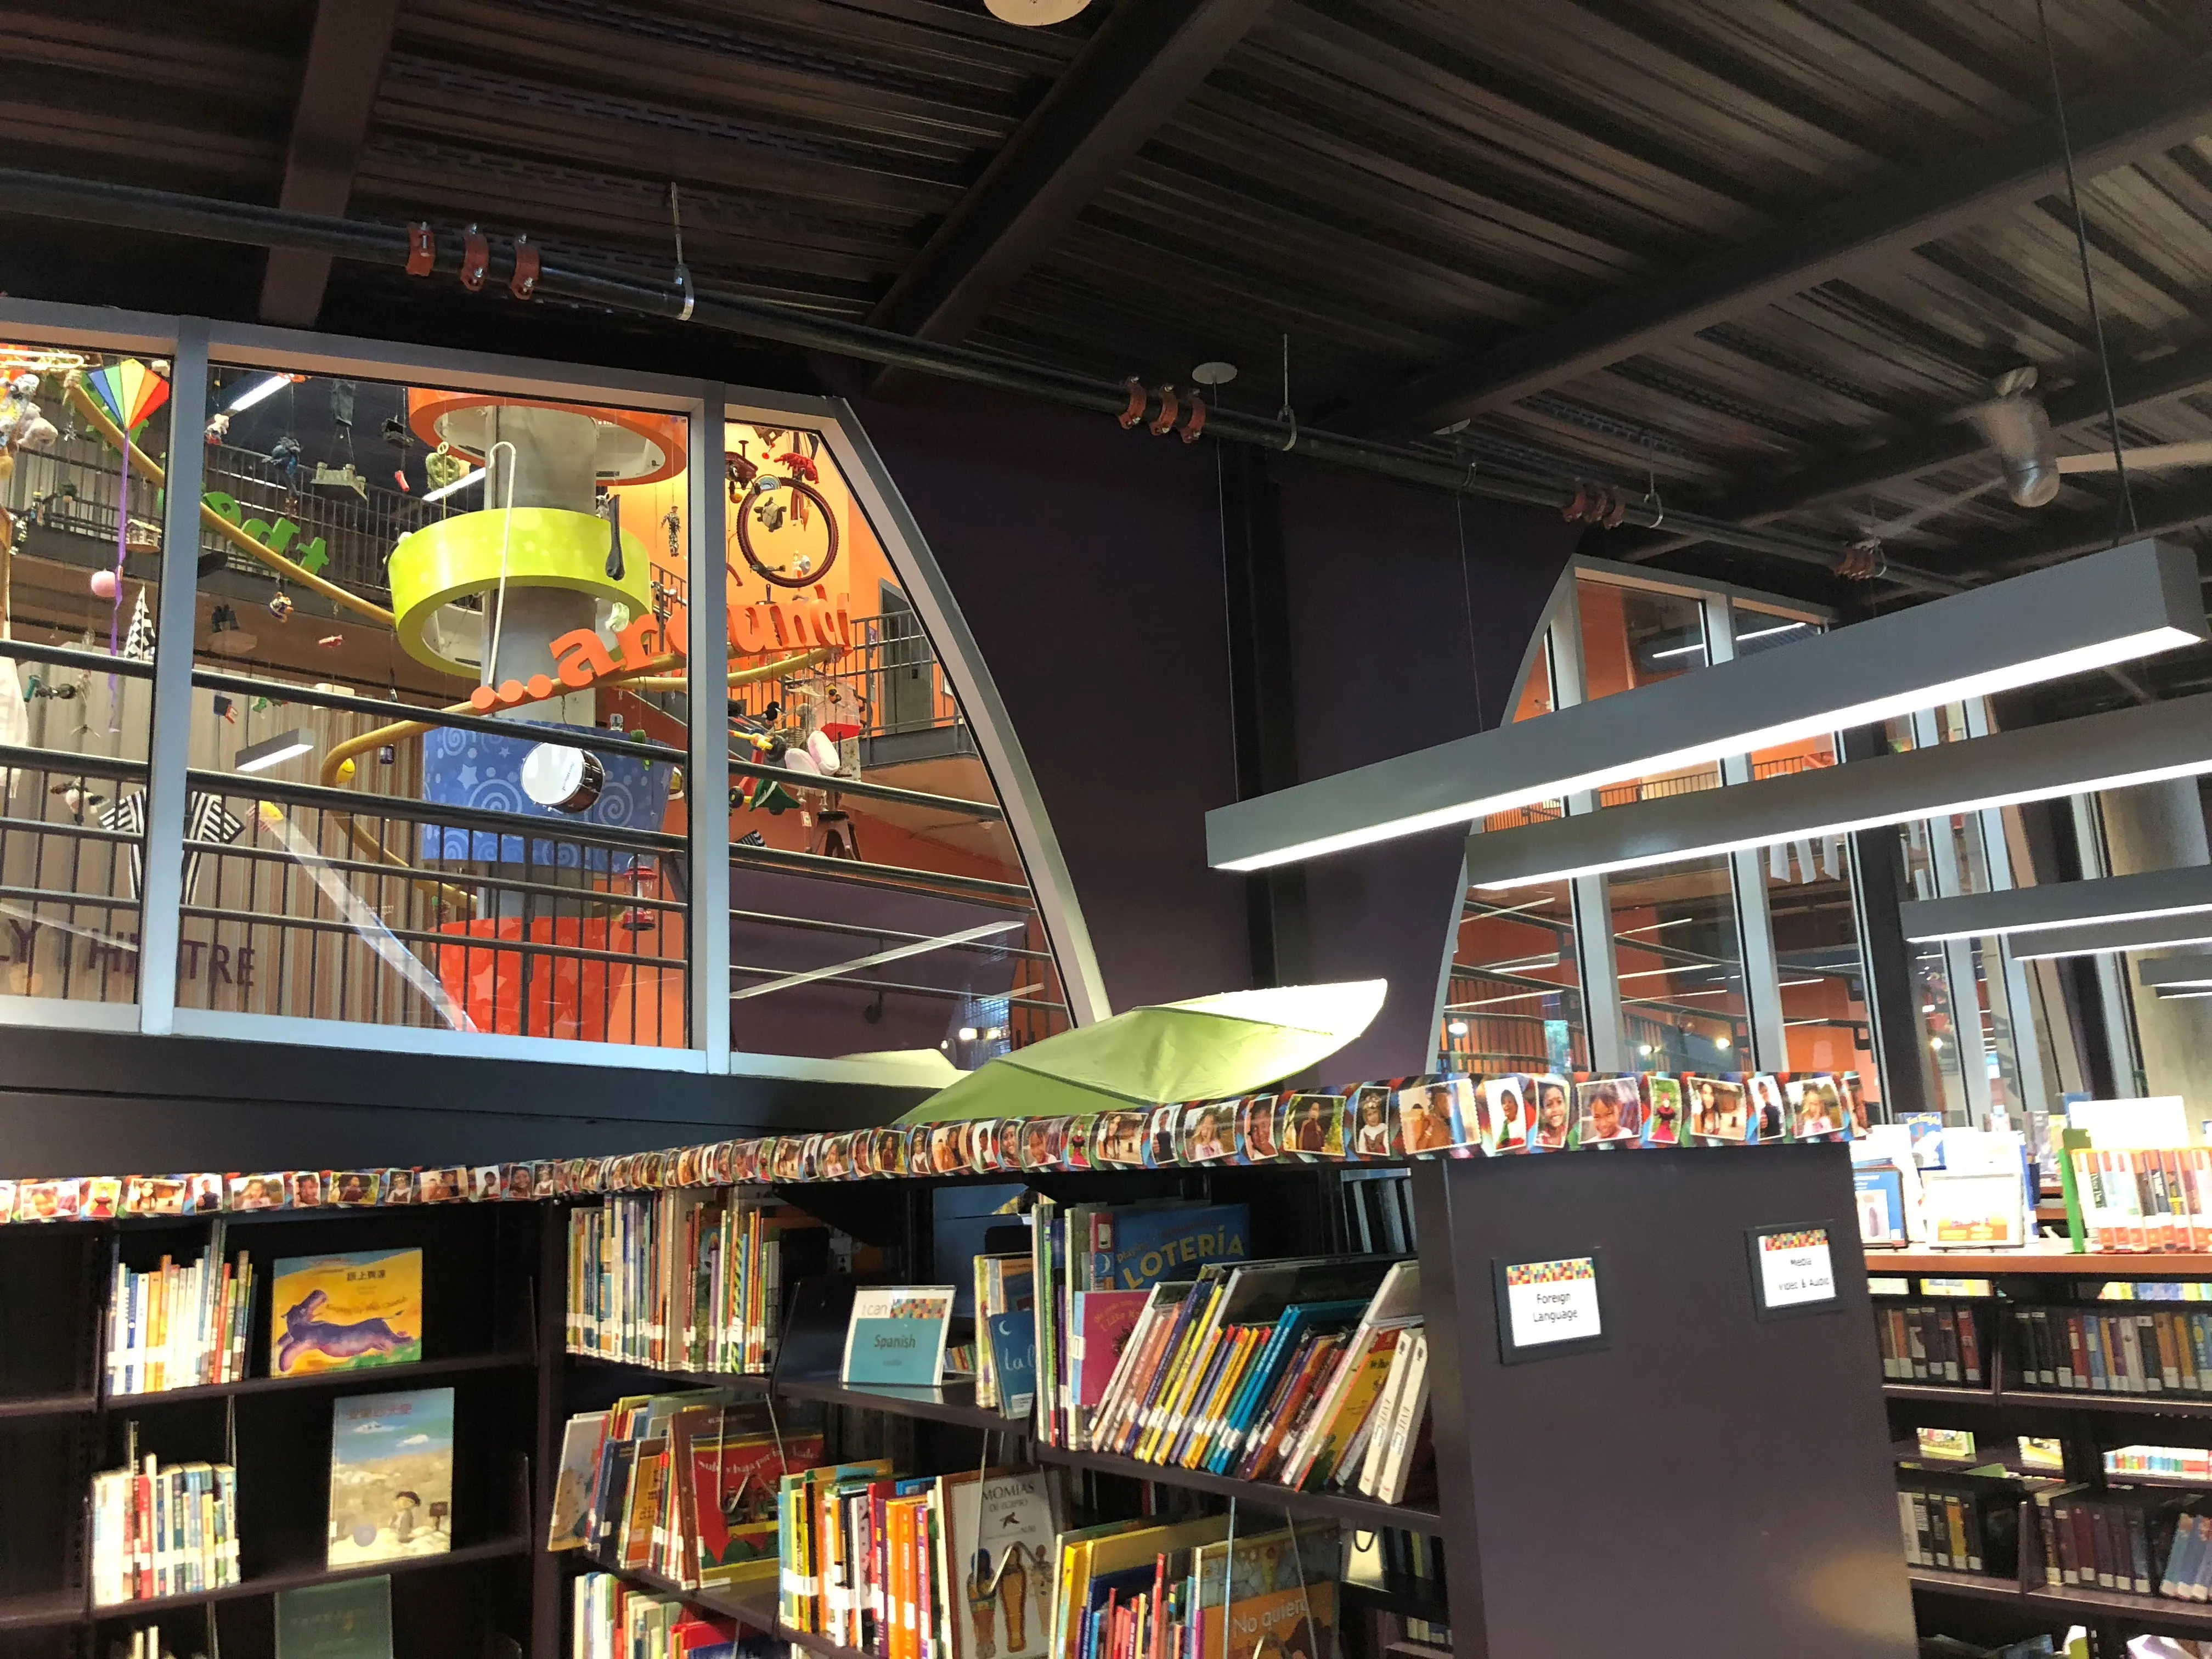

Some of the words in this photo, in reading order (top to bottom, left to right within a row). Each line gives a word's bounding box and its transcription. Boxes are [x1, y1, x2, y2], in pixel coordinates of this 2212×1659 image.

[1790, 1258, 1812, 1266] Media
[1536, 1293, 1571, 1305] Foreign
[867, 1304, 888, 1316] can
[1533, 1310, 1578, 1323] Language
[874, 1334, 916, 1349] Spanish
[1233, 1612, 1258, 1638] No
